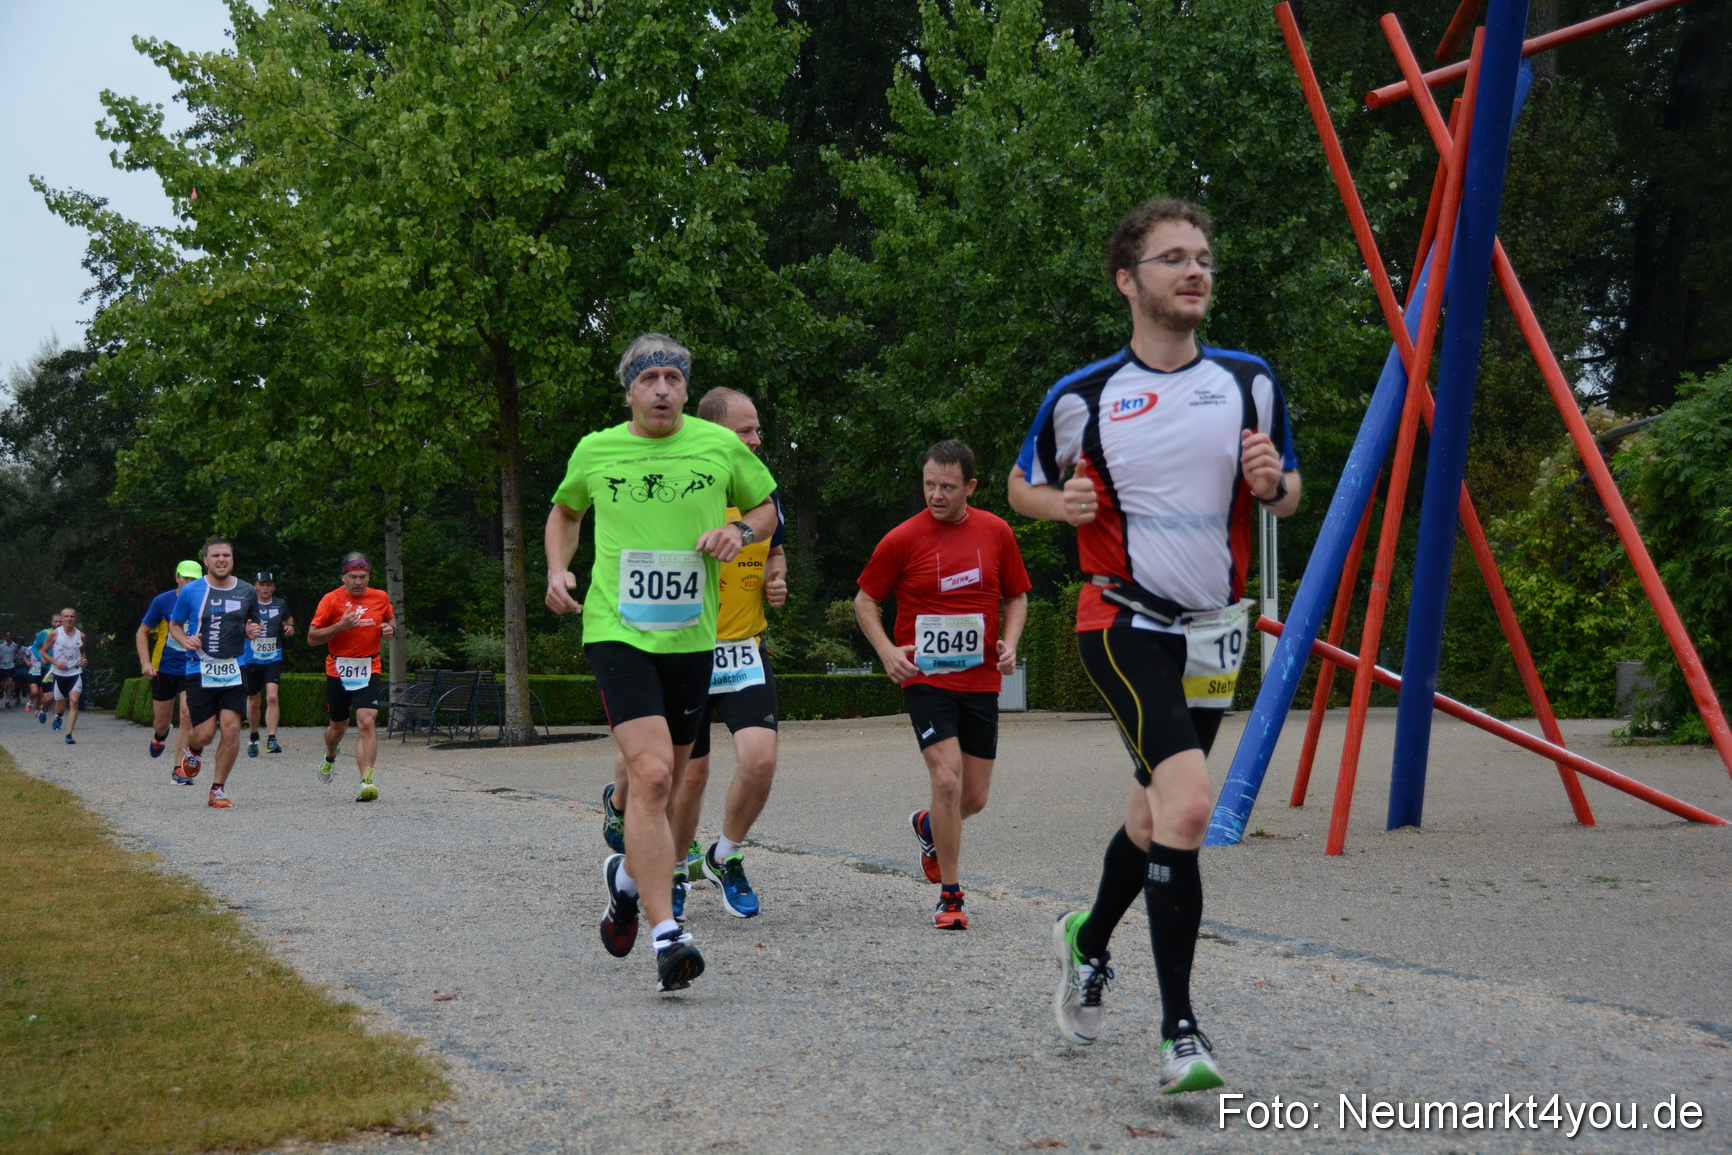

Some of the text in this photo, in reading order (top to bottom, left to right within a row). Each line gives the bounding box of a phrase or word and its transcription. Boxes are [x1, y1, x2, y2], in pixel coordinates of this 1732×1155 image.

[1112, 397, 1144, 413] tkn
[629, 569, 698, 600] 3054
[951, 575, 969, 586] DEHN
[208, 598, 223, 653] HIMATEC
[922, 629, 978, 654] 2649
[1213, 629, 1242, 669] 19
[206, 663, 236, 675] 2098
[932, 659, 966, 668] Thomas
[338, 665, 368, 678] 2614
[711, 673, 747, 685] Joachim
